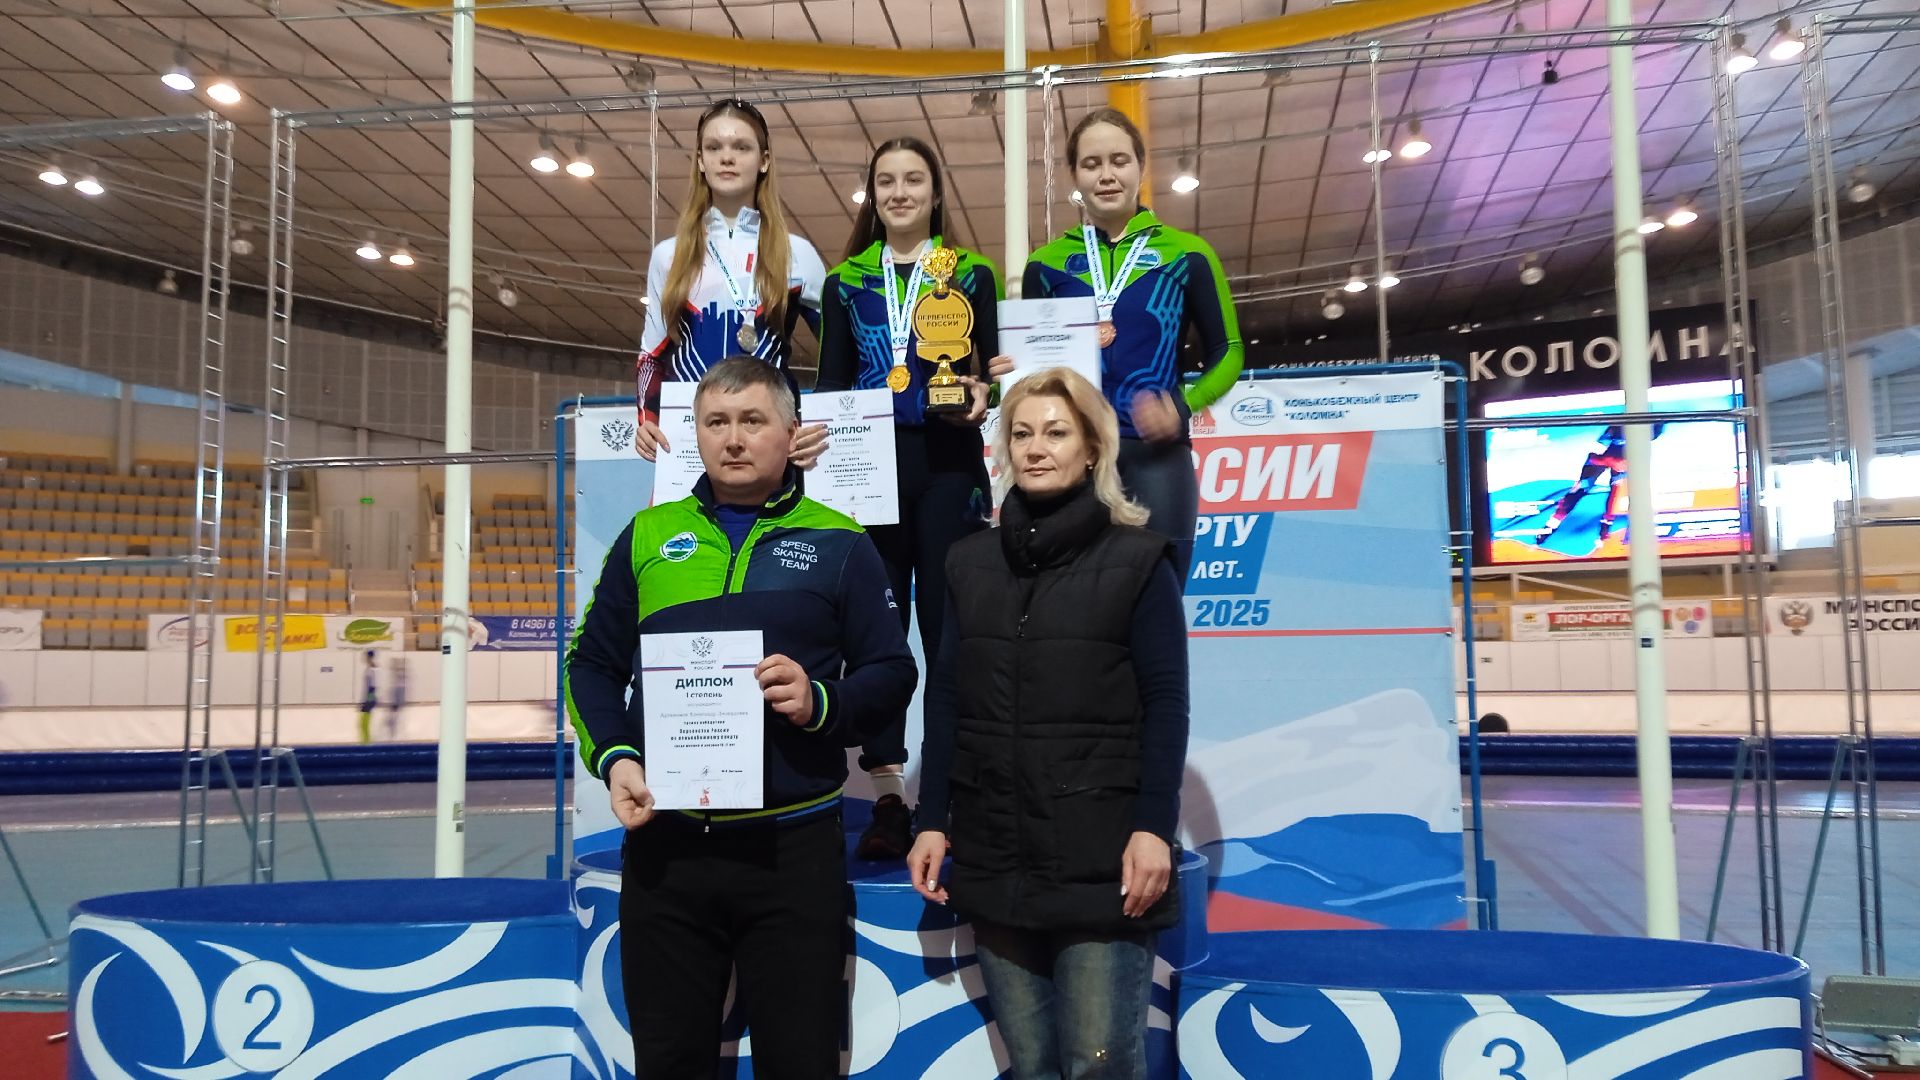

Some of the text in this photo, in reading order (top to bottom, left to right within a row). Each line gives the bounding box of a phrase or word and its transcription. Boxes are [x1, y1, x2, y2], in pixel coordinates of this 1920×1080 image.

[926, 320, 959, 328] РОССИИ
[1283, 392, 1421, 408] КОНЬКОБЕЖНЫЙ ЦЕНТР
[827, 425, 872, 436] ДИПЛОМ
[1191, 443, 1342, 503] СИИ
[1194, 514, 1260, 548] РТУ
[780, 540, 816, 553] SPEED
[772, 547, 818, 563] SKATING
[780, 558, 810, 571] TEAM
[1192, 599, 1271, 627] 2025
[1554, 611, 1633, 625] ЛОР-ОРГА
[511, 619, 519, 629] 8
[675, 676, 734, 690] ДИПЛОМ
[242, 983, 283, 1051] 2
[1482, 1036, 1526, 1080] 3
